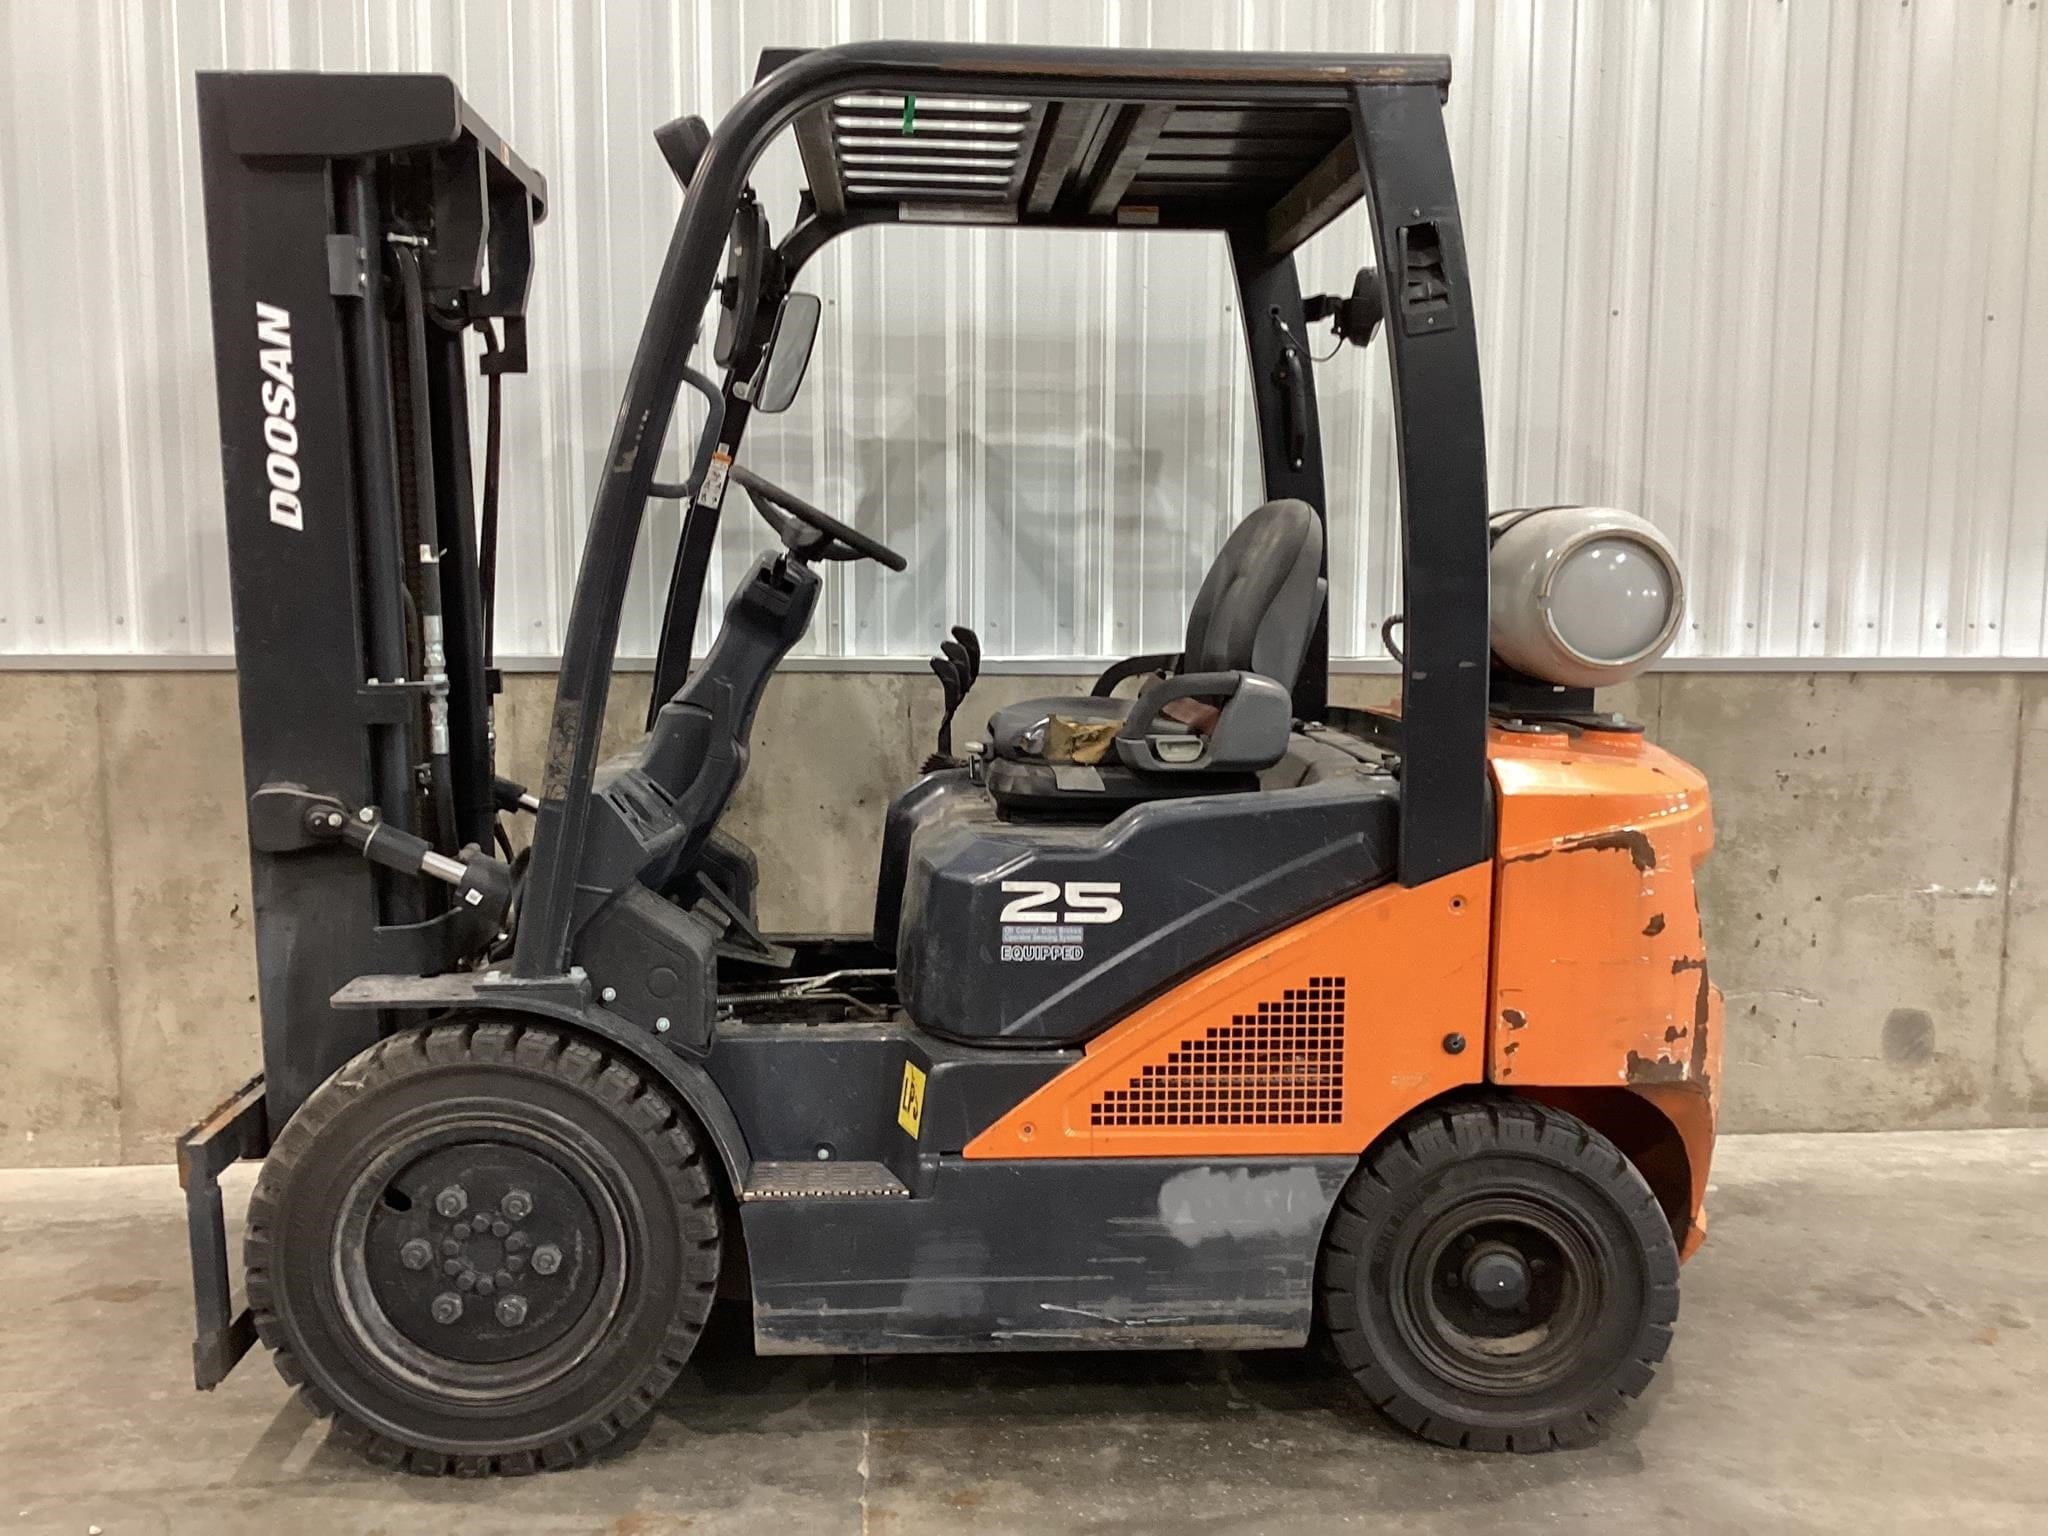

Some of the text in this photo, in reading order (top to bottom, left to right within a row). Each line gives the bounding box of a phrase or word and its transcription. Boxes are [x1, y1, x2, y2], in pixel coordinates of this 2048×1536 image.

[256, 301, 304, 531] DOOSAN
[1000, 881, 1123, 923] 25
[1001, 945, 1084, 962] EQUIPPED
